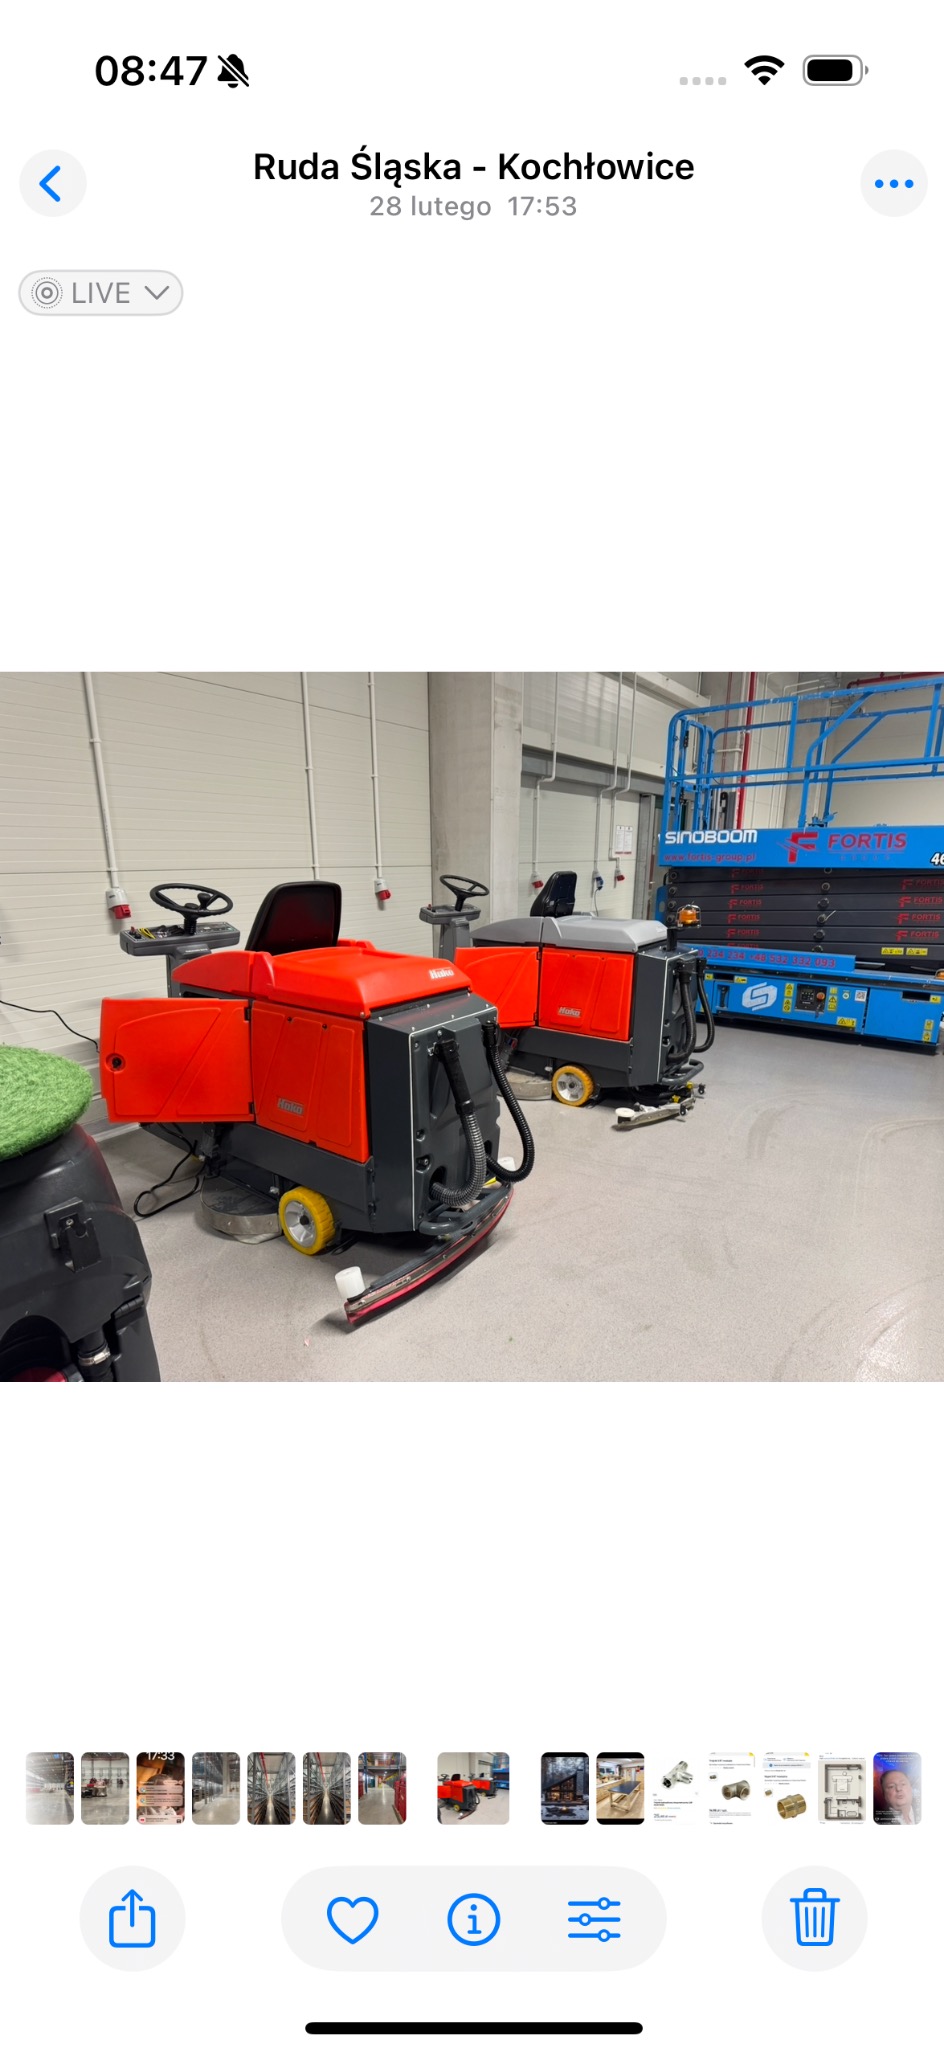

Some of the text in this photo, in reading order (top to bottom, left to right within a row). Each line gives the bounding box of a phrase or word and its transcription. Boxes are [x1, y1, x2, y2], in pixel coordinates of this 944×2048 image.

[95, 55, 208, 87] 08:47
[254, 151, 339, 181] Ruda
[351, 144, 461, 189] Śląska
[499, 151, 695, 181] Kochłowice
[370, 195, 577, 221] 28 lutego 17:53
[72, 282, 130, 304] LIVE
[664, 830, 758, 844] SINOBOOM
[827, 833, 908, 849] FORTIS
[664, 852, 756, 864] www.fortis-group.pl
[910, 930, 940, 938] FORTIS
[769, 954, 788, 964] 532
[792, 956, 811, 967] 332
[814, 957, 836, 968] 093
